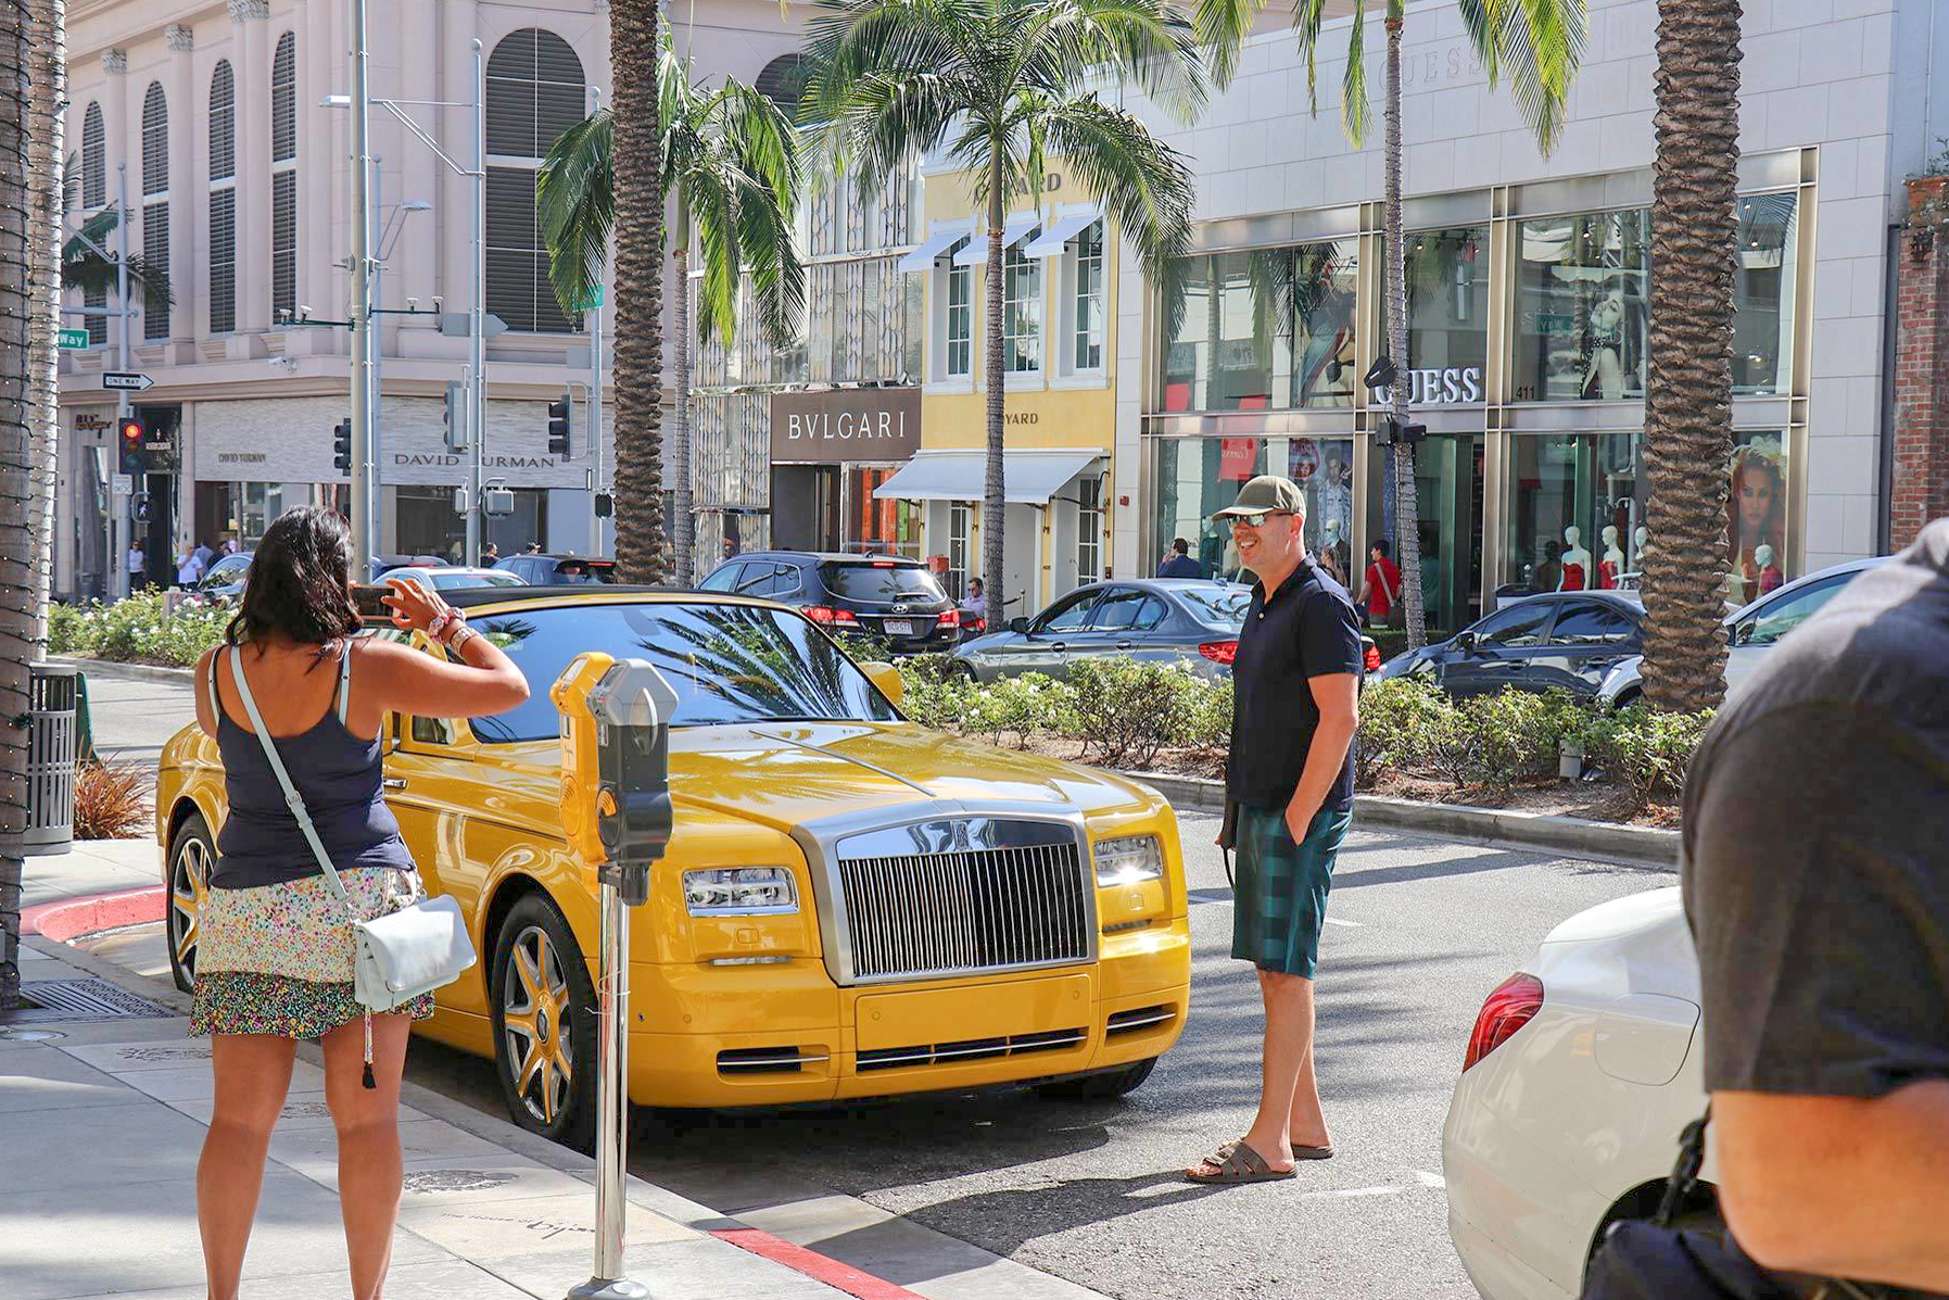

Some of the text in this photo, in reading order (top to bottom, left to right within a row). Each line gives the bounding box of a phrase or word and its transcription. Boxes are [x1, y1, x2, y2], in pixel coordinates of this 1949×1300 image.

[60, 334, 84, 347] Way
[1516, 385, 1535, 400] 411
[788, 411, 905, 440] BVLGARI
[1005, 412, 1039, 425] YARD
[394, 454, 555, 468] DAVID URMAN
